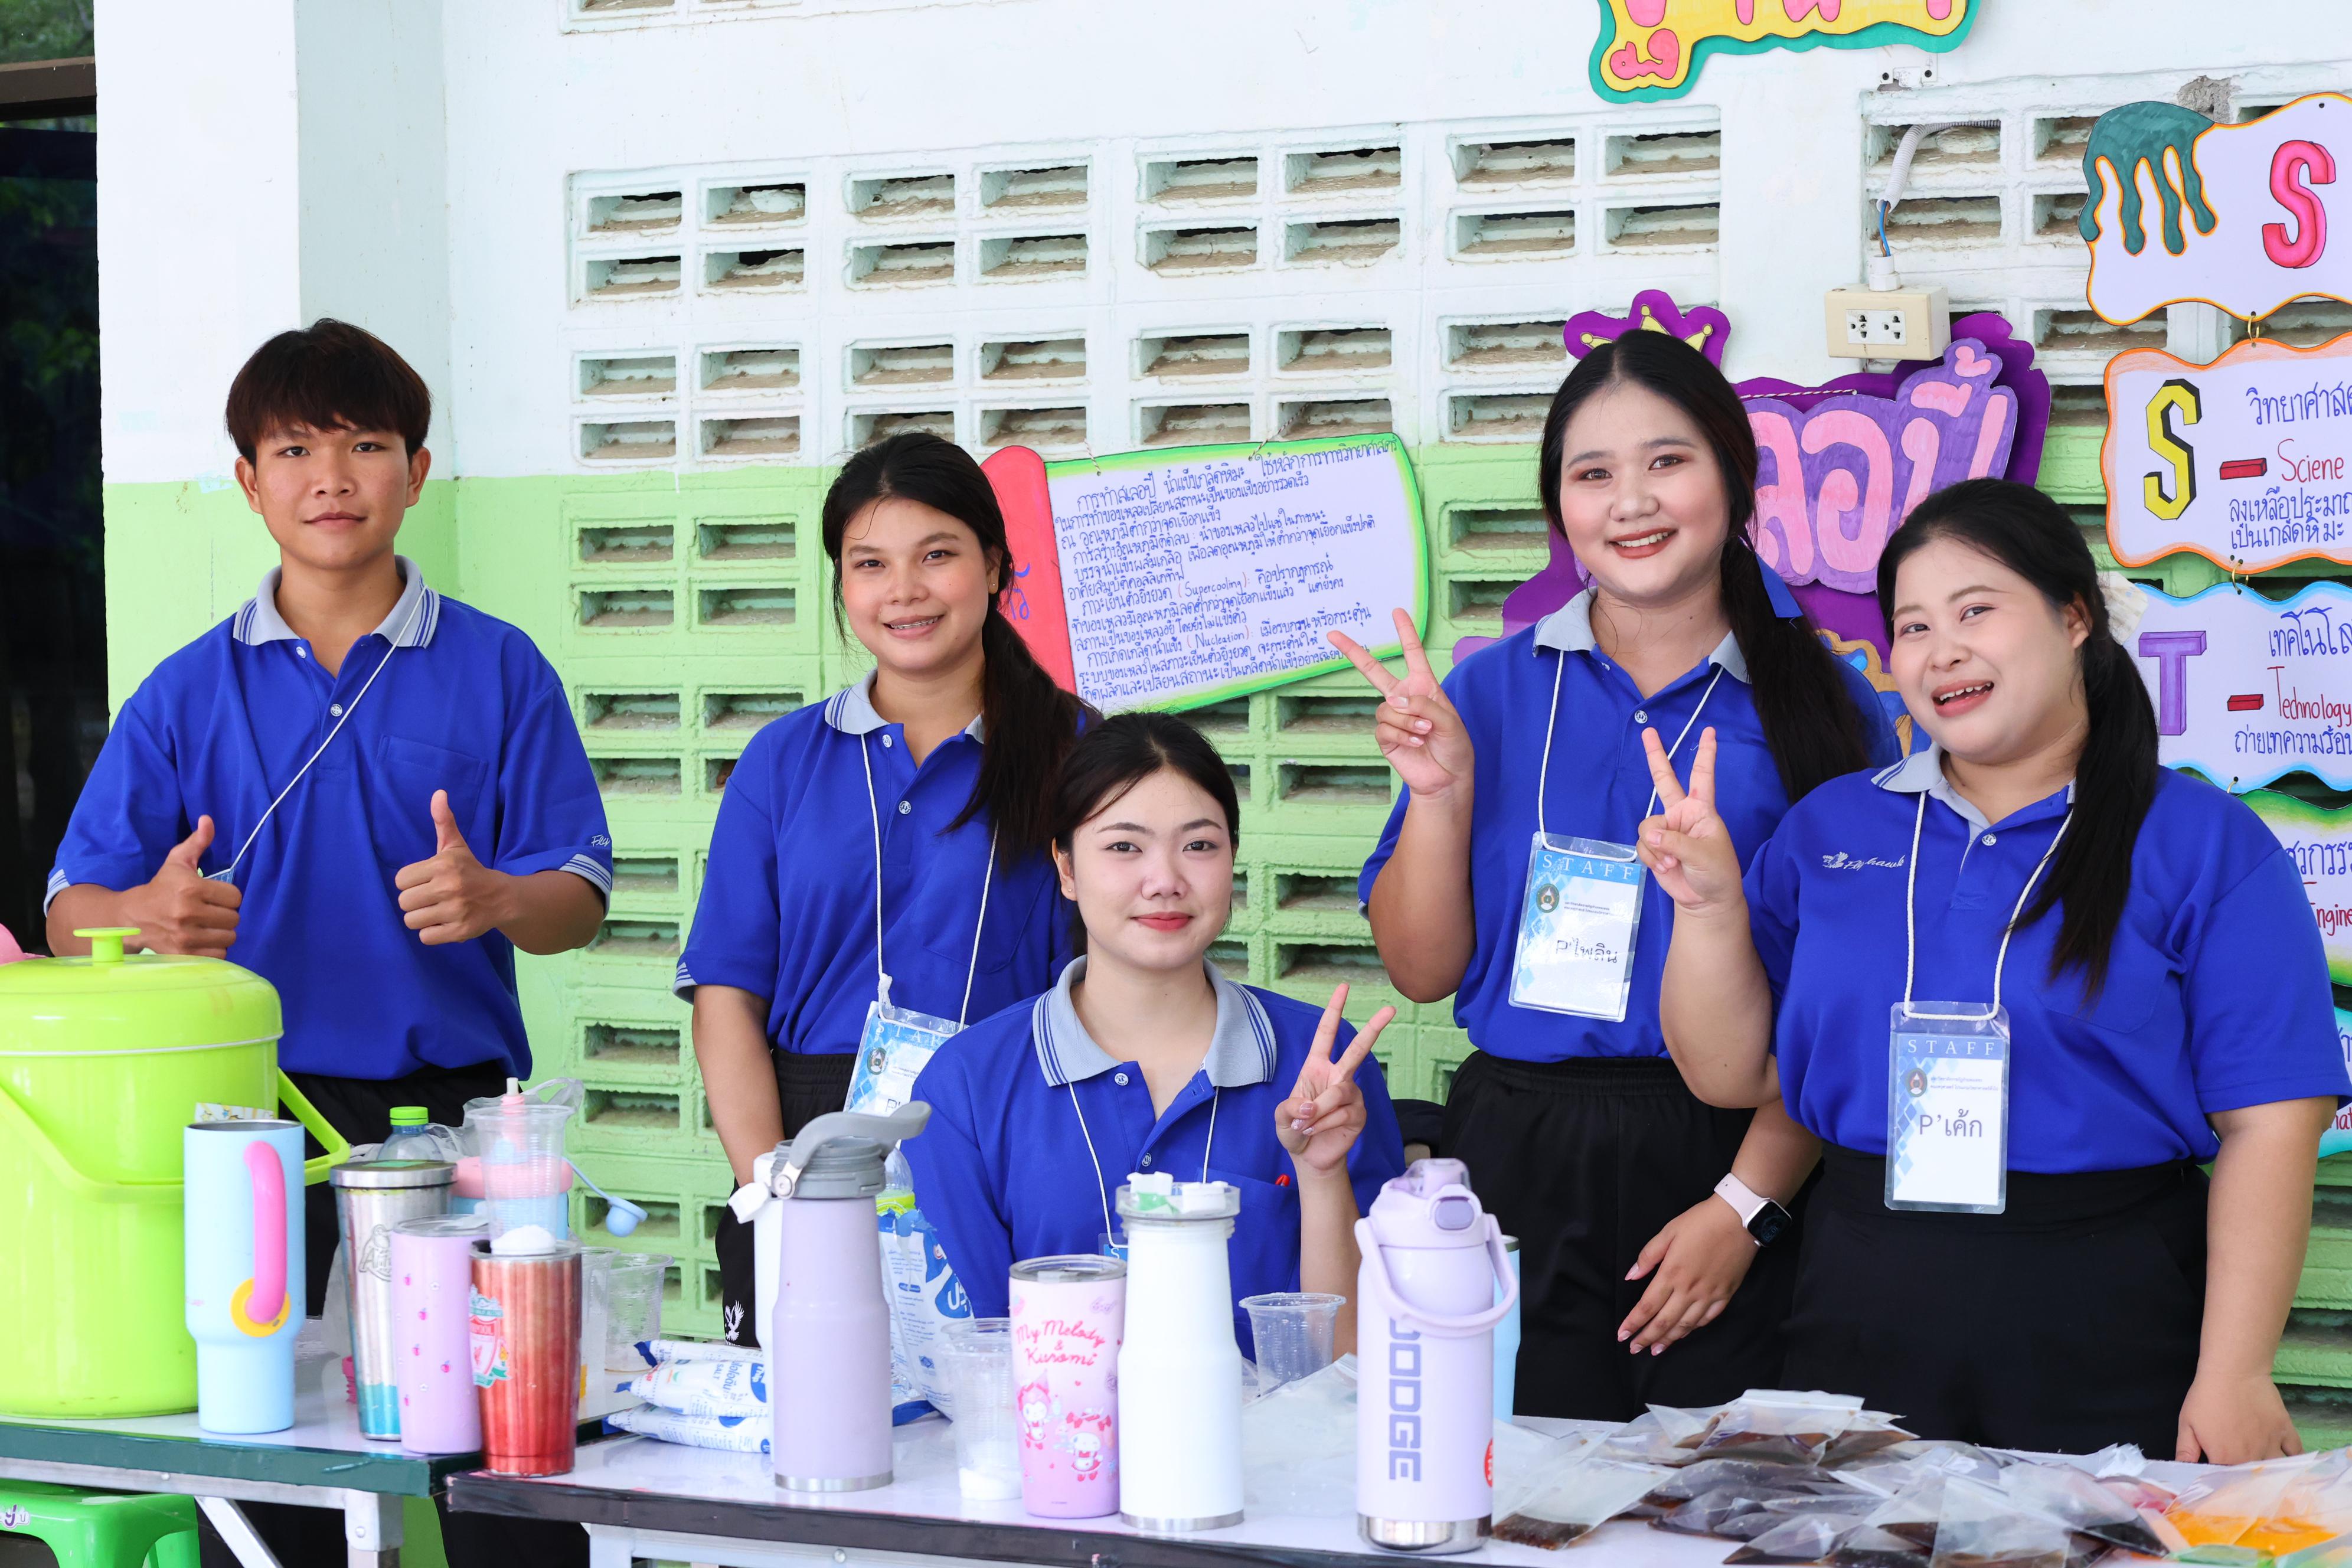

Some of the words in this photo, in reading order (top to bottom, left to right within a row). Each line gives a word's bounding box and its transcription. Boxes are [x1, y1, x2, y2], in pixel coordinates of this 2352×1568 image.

[2262, 139, 2337, 269] S
[2143, 378, 2203, 521] S
[2278, 438, 2344, 483] Sciene
[2138, 630, 2207, 737] T
[2267, 666, 2352, 727] Technology
[1541, 854, 1634, 880] STAFF
[1907, 1038, 1995, 1056] STAFF
[1015, 1324, 1040, 1344] My
[1041, 1319, 1106, 1348] Melody
[1024, 1347, 1098, 1367] Kuromi
